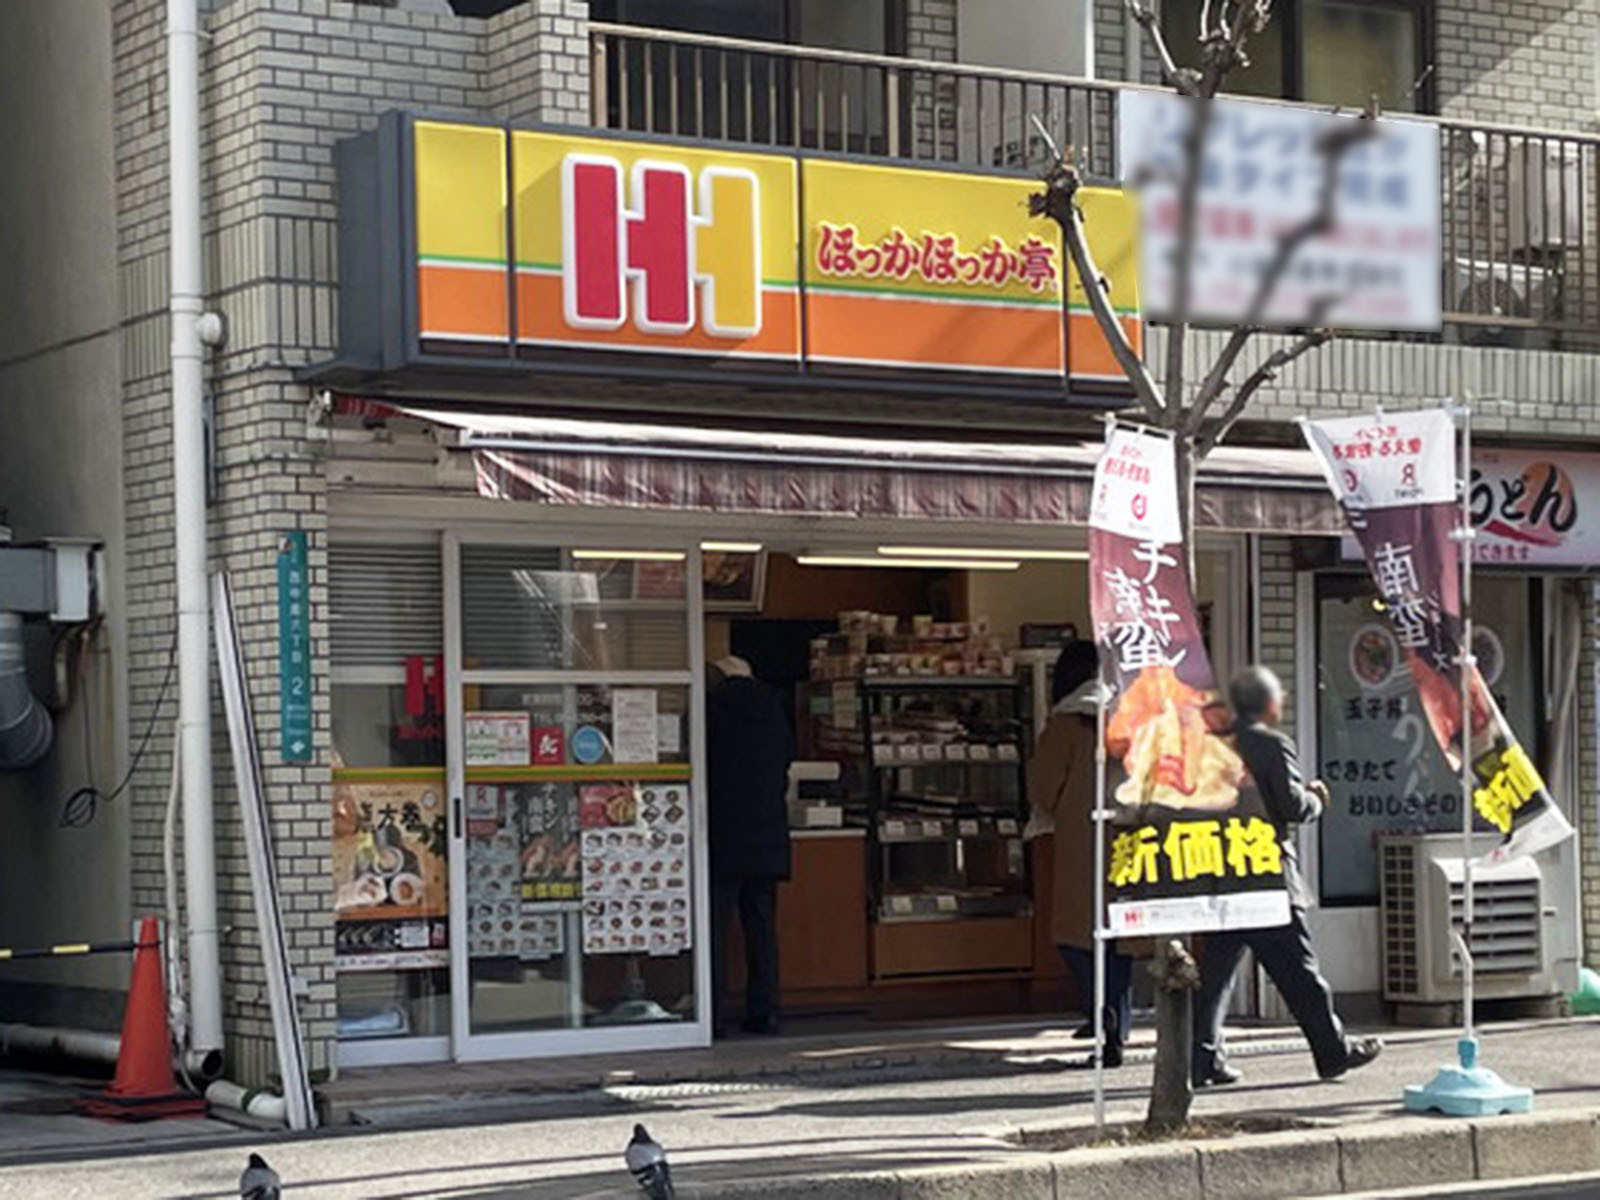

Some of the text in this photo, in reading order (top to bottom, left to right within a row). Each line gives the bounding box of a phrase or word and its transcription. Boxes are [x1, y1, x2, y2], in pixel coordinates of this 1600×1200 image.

[818, 224, 1057, 291] ほっかほっか亭
[1325, 759, 1397, 783] できたて
[1108, 816, 1283, 887] 新価格
